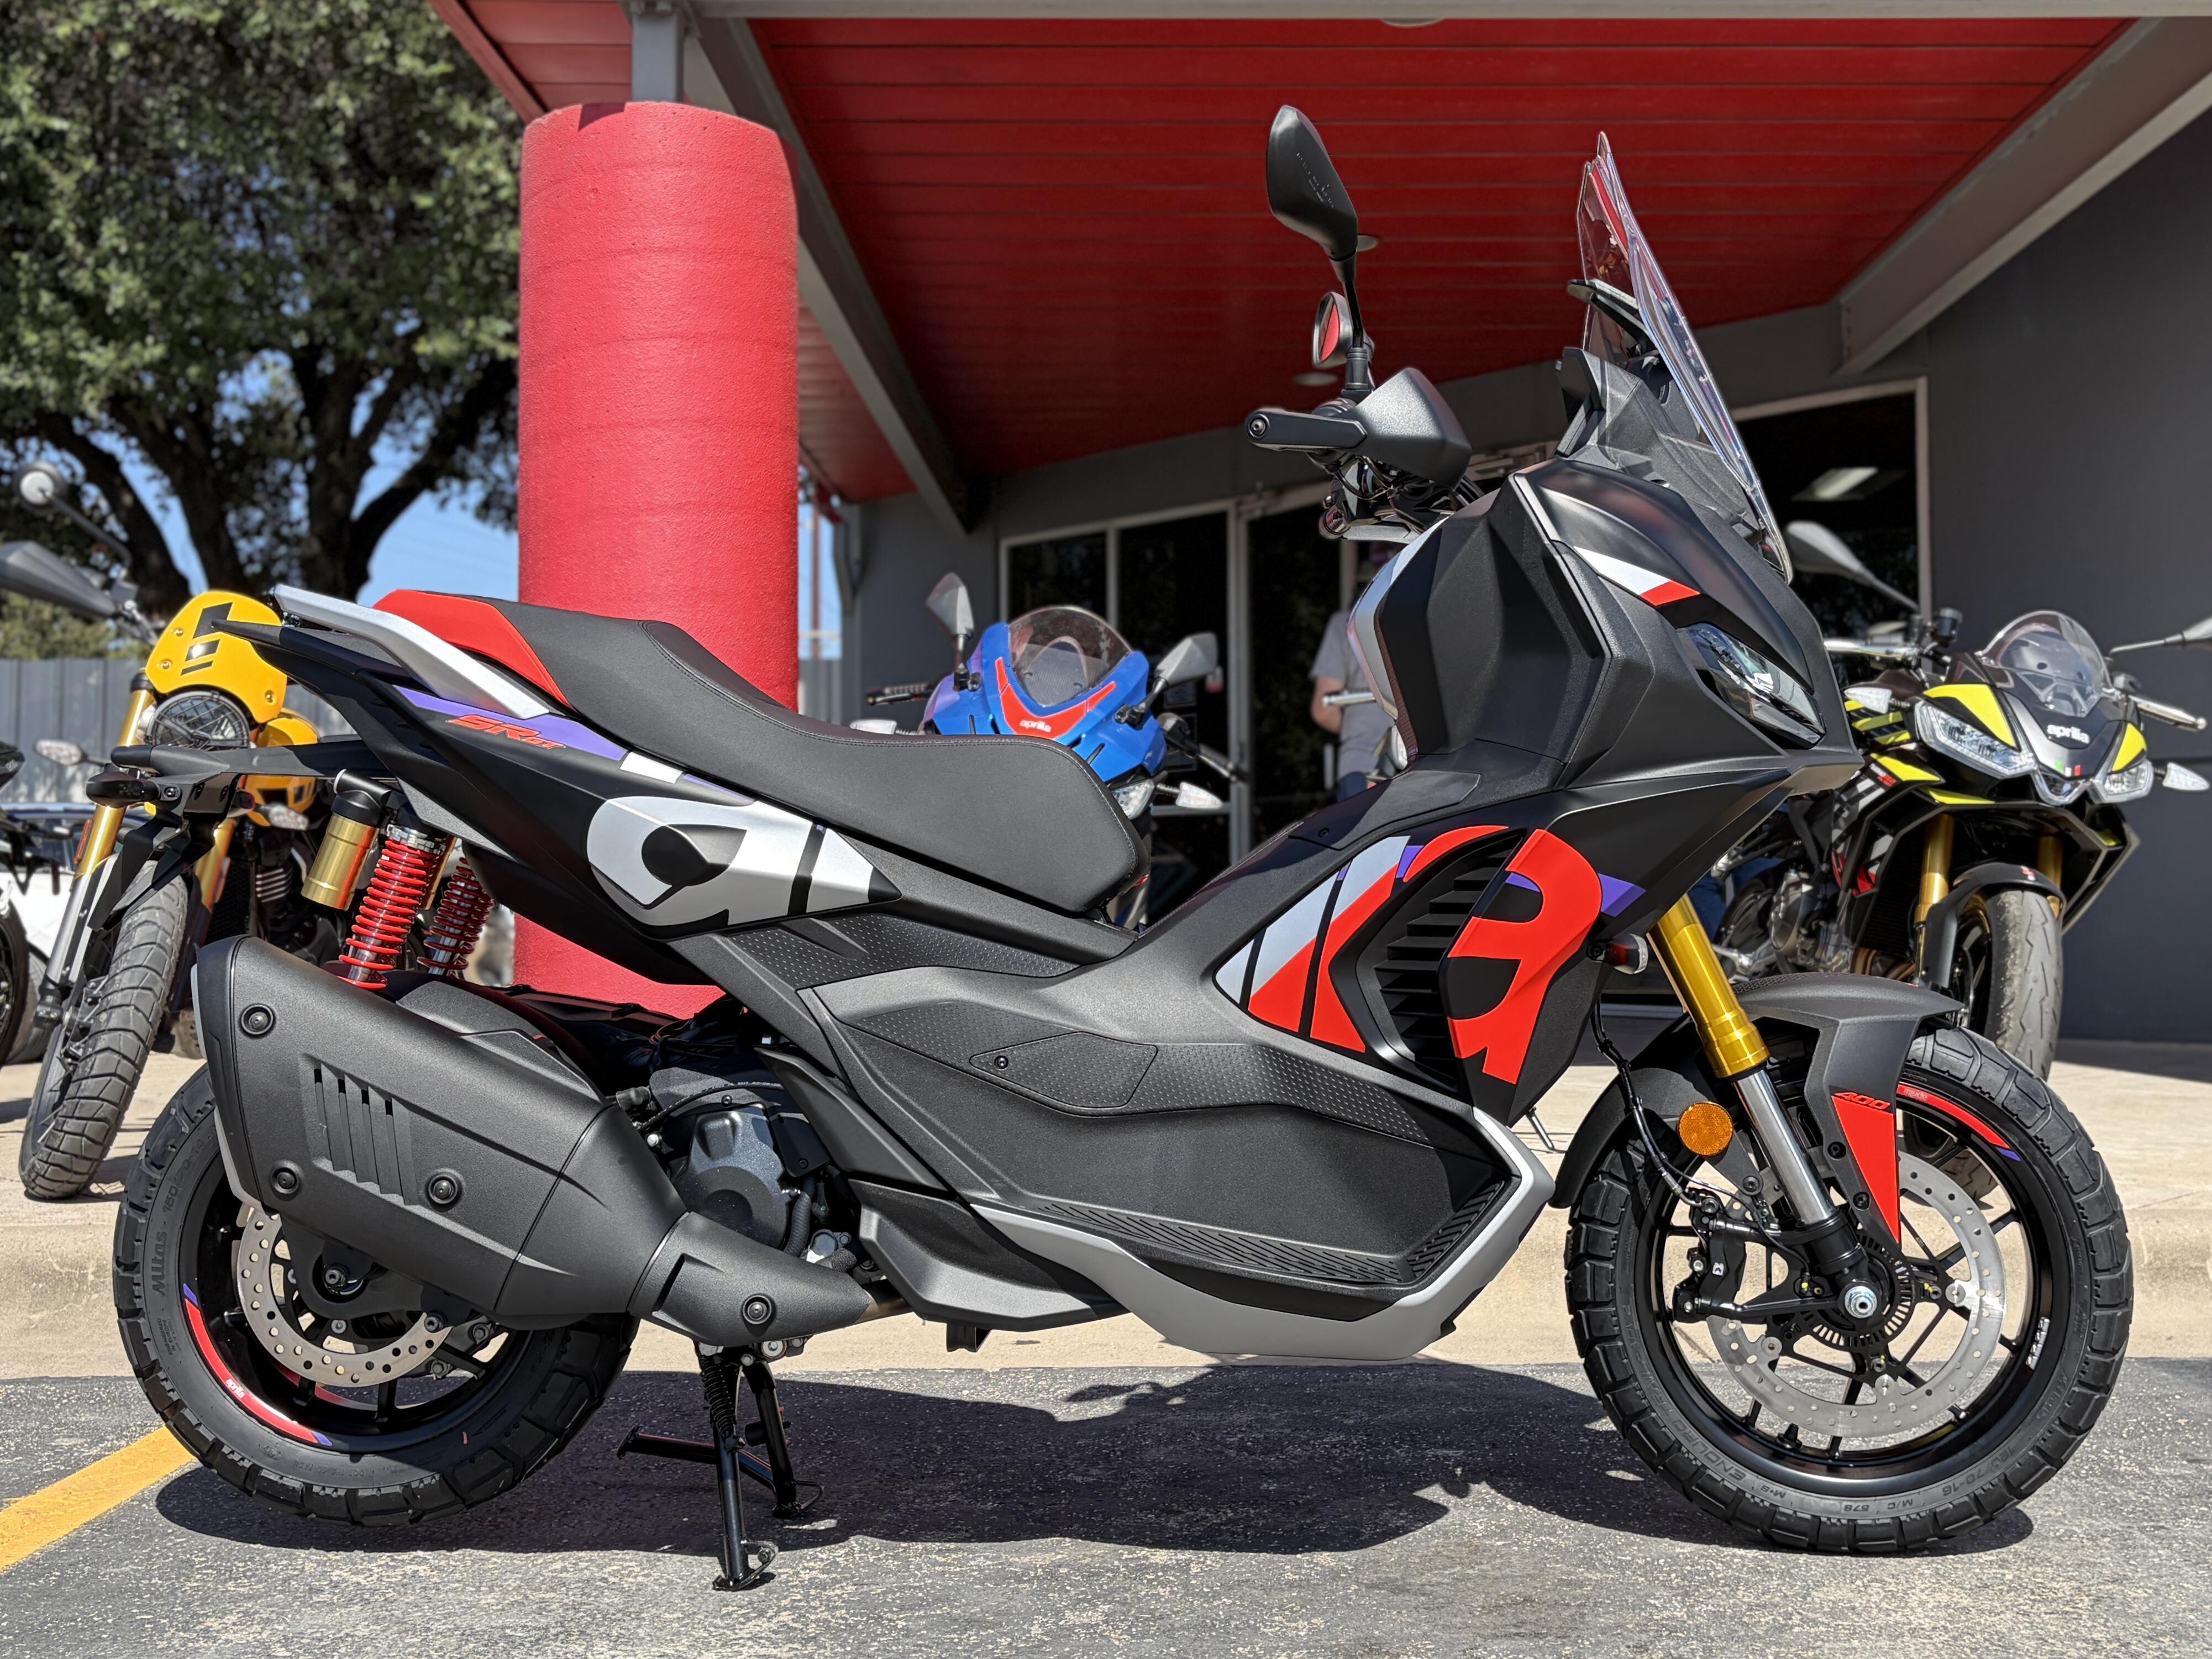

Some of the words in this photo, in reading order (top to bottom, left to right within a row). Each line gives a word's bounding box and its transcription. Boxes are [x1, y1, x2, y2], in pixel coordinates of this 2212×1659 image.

[1020, 720, 1052, 733] aprilia
[2046, 724, 2090, 744] aprilia
[1834, 1091, 1891, 1110] 400
[151, 1231, 167, 1296] Mitas
[225, 1378, 245, 1399] aprilia
[1671, 1419, 1747, 1482] ENDURO
[1843, 1504, 1869, 1512] 578
[1887, 1498, 1913, 1510] M/C
